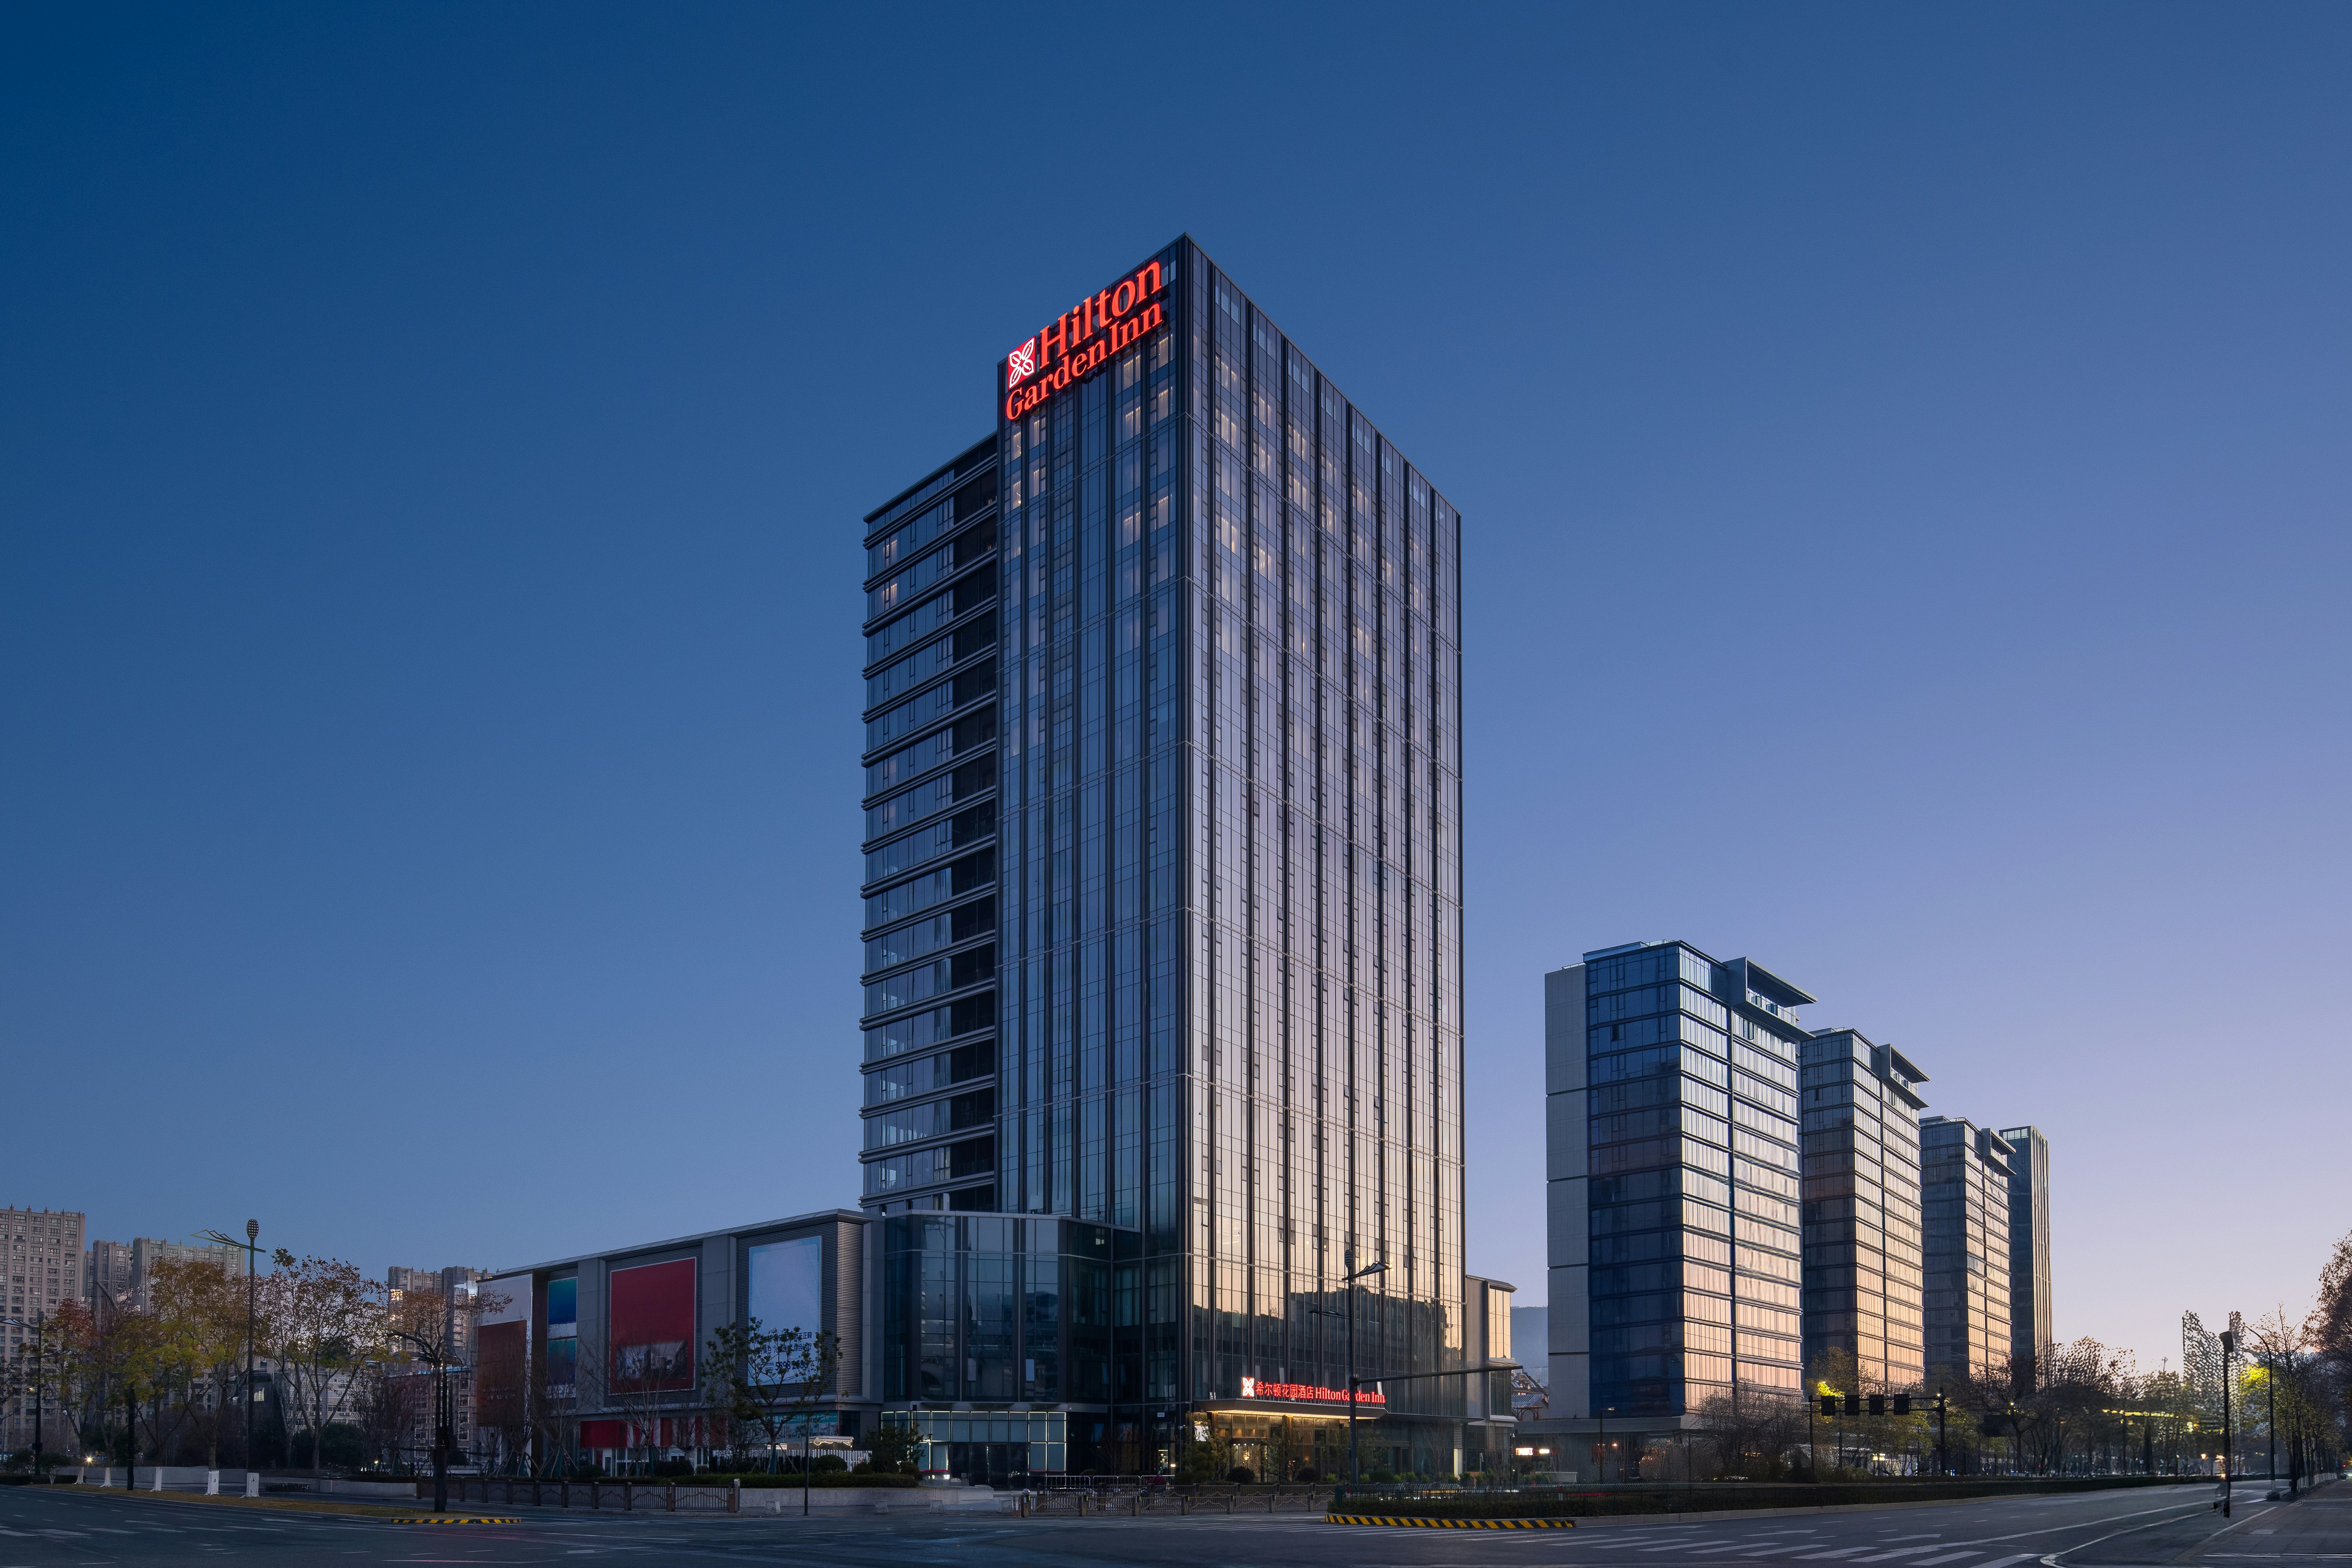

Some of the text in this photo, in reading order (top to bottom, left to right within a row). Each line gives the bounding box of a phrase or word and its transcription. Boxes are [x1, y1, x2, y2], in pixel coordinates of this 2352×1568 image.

[1006, 303, 1163, 420] Garden Inn
[1040, 261, 1162, 370] Hilton
[1255, 1381, 1313, 1399] 希尔顿花园酒店
[1315, 1387, 1341, 1400] Hilton
[1342, 1389, 1370, 1402] Gaden
